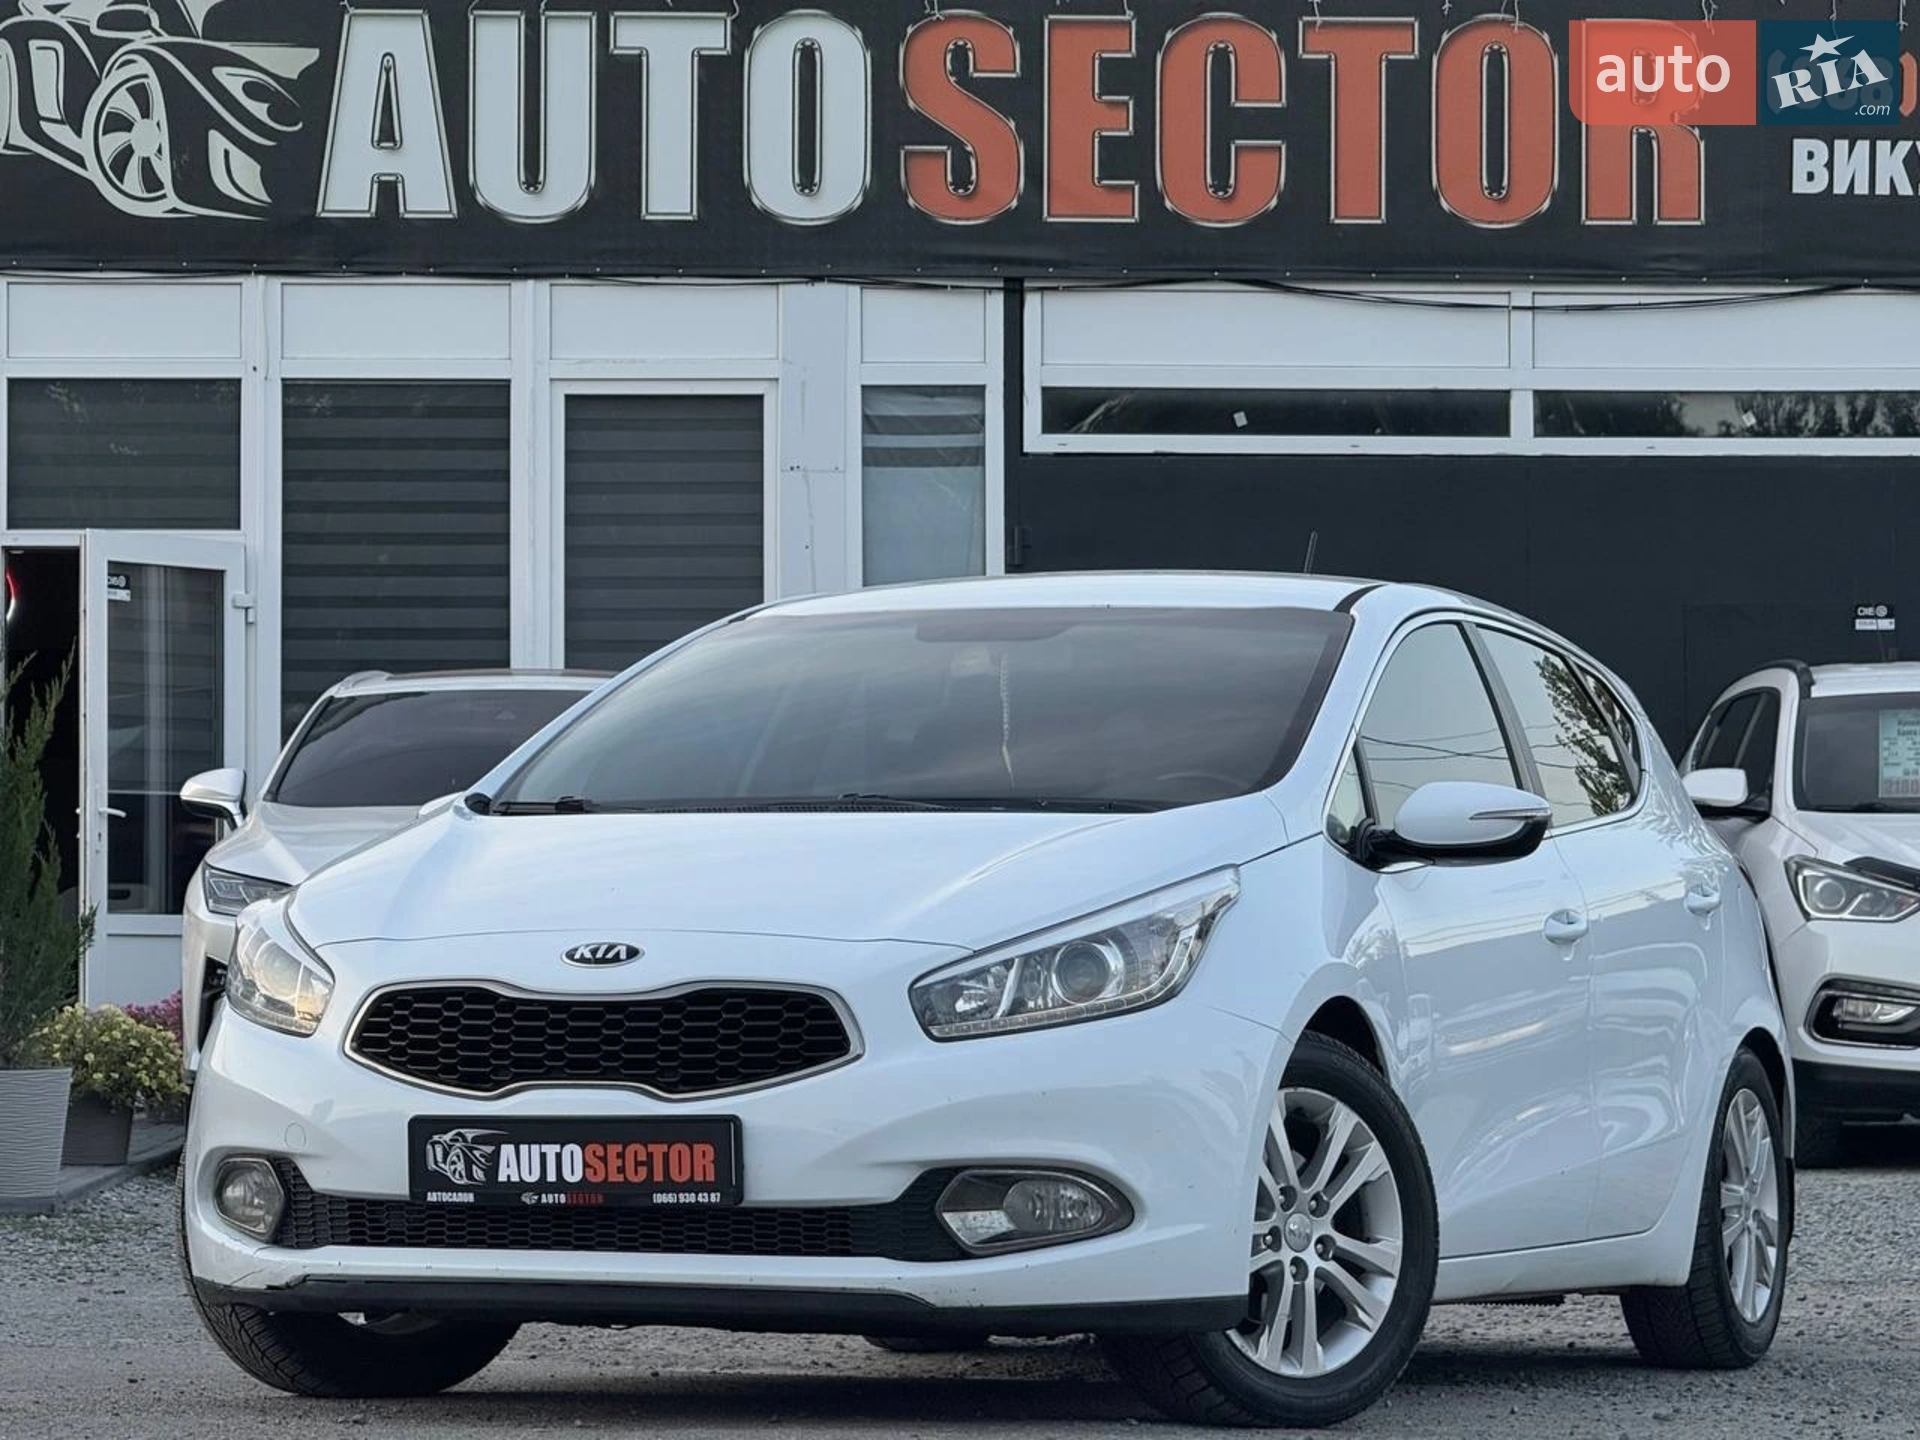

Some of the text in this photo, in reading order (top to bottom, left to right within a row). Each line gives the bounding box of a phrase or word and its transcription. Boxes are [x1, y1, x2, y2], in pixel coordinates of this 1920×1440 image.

[1791, 138, 1920, 196] ВИК
[573, 944, 628, 960] KIA
[497, 1143, 715, 1185] AUTOSECTOR
[697, 1192, 709, 1203] 43
